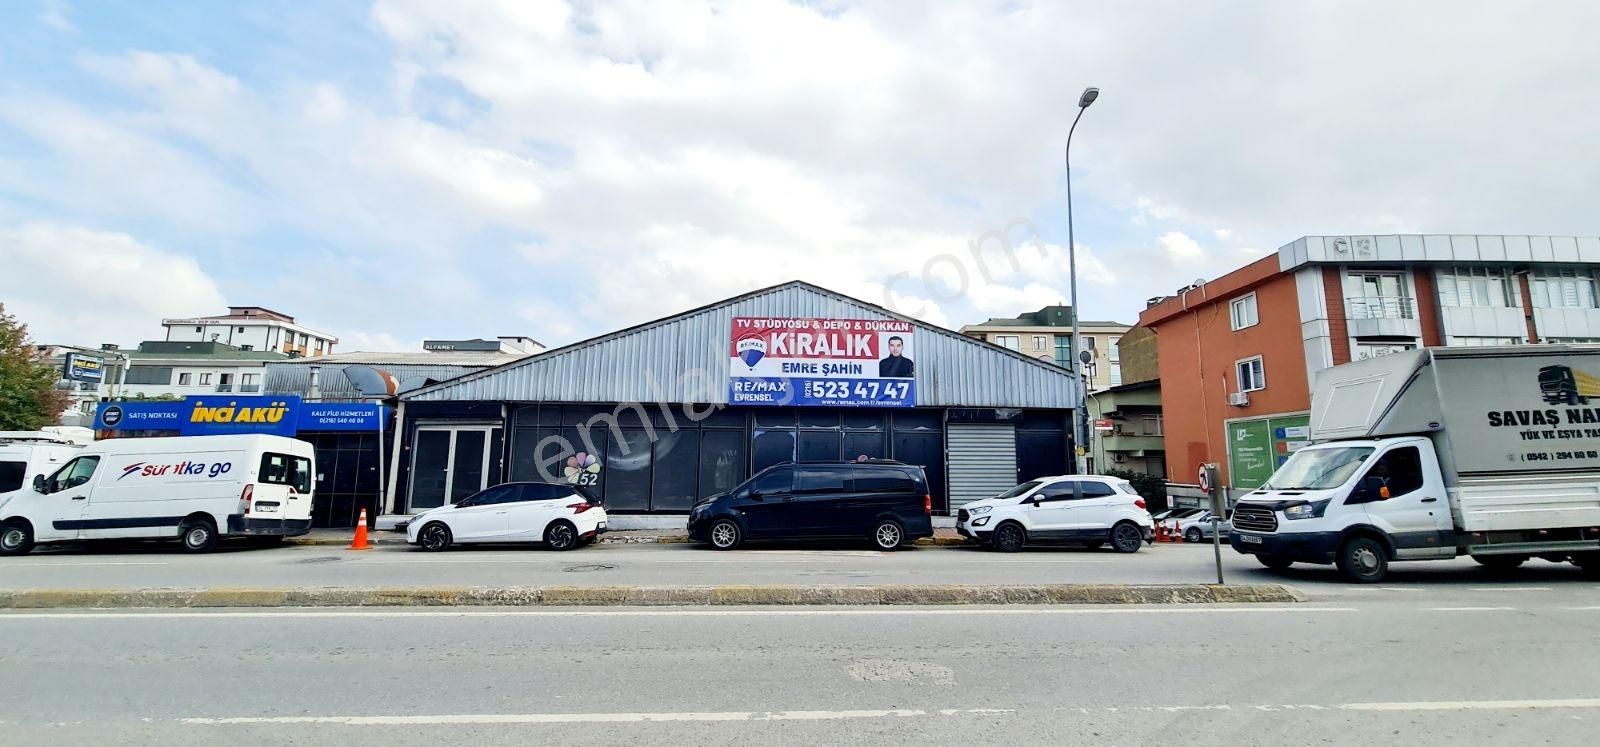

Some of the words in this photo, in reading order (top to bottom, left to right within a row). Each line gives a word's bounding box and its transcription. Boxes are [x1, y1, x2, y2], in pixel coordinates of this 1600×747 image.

[737, 319, 751, 328] TV
[753, 318, 810, 329] STÜDYOSU
[812, 320, 820, 329] &
[823, 320, 851, 330] DEPO
[854, 321, 862, 330] &
[865, 321, 909, 332] DÜKKAN
[781, 362, 818, 374] EMRE
[822, 361, 862, 377] ŞAHİN
[734, 381, 786, 392] RE/MAX
[812, 381, 850, 399] 523
[853, 382, 880, 399] 47
[883, 382, 910, 400] 47
[734, 393, 774, 402] EVRENSEL
[128, 412, 147, 420] SATIŞ
[190, 401, 237, 422] İNCİ
[234, 401, 286, 422] AKÜ
[1487, 409, 1560, 428] SAVAŞ
[1520, 429, 1540, 440] YÜK
[1541, 430, 1555, 439] VE
[1557, 429, 1583, 440] EŞYA
[580, 474, 598, 486] 52
